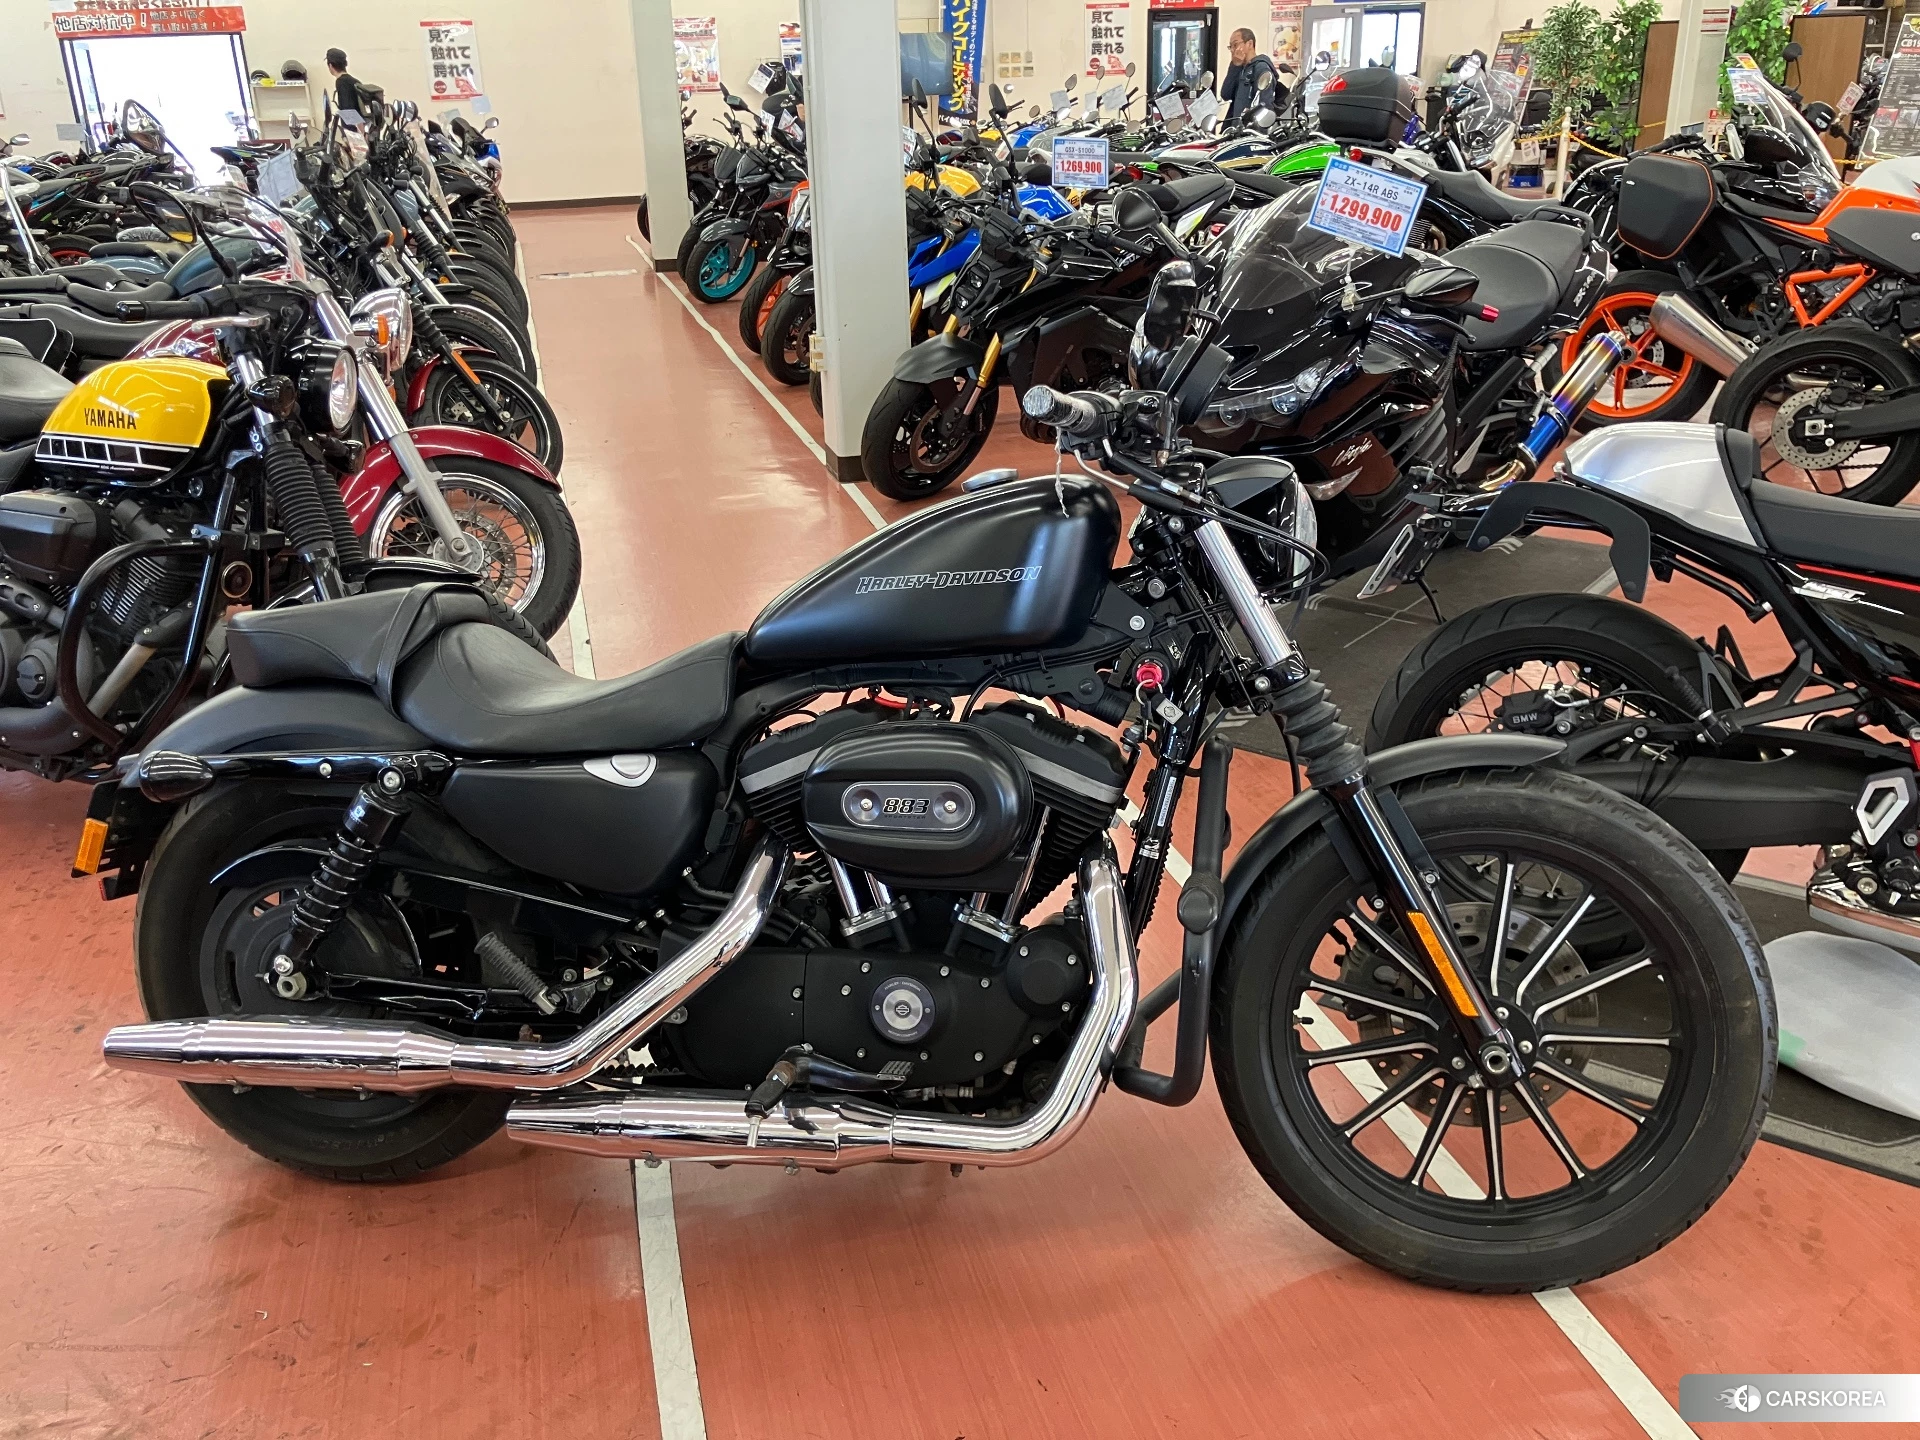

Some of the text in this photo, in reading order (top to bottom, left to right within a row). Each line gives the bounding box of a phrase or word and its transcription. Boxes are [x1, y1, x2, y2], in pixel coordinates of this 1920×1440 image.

[55, 12, 147, 33] 他店対抗中！
[1091, 10, 1113, 24] 見て
[1091, 26, 1125, 39] 触れて
[430, 46, 471, 60] 触れて
[1060, 160, 1102, 174] 1,269,900
[1344, 175, 1380, 195] ZX-14R
[1380, 188, 1399, 201] ABS
[1329, 193, 1403, 232] 1,299,900
[84, 407, 137, 430] YAMAHA
[855, 565, 1043, 595] HARLEY-DAVIDSON
[1512, 712, 1538, 724] BMW
[882, 797, 931, 815] 883
